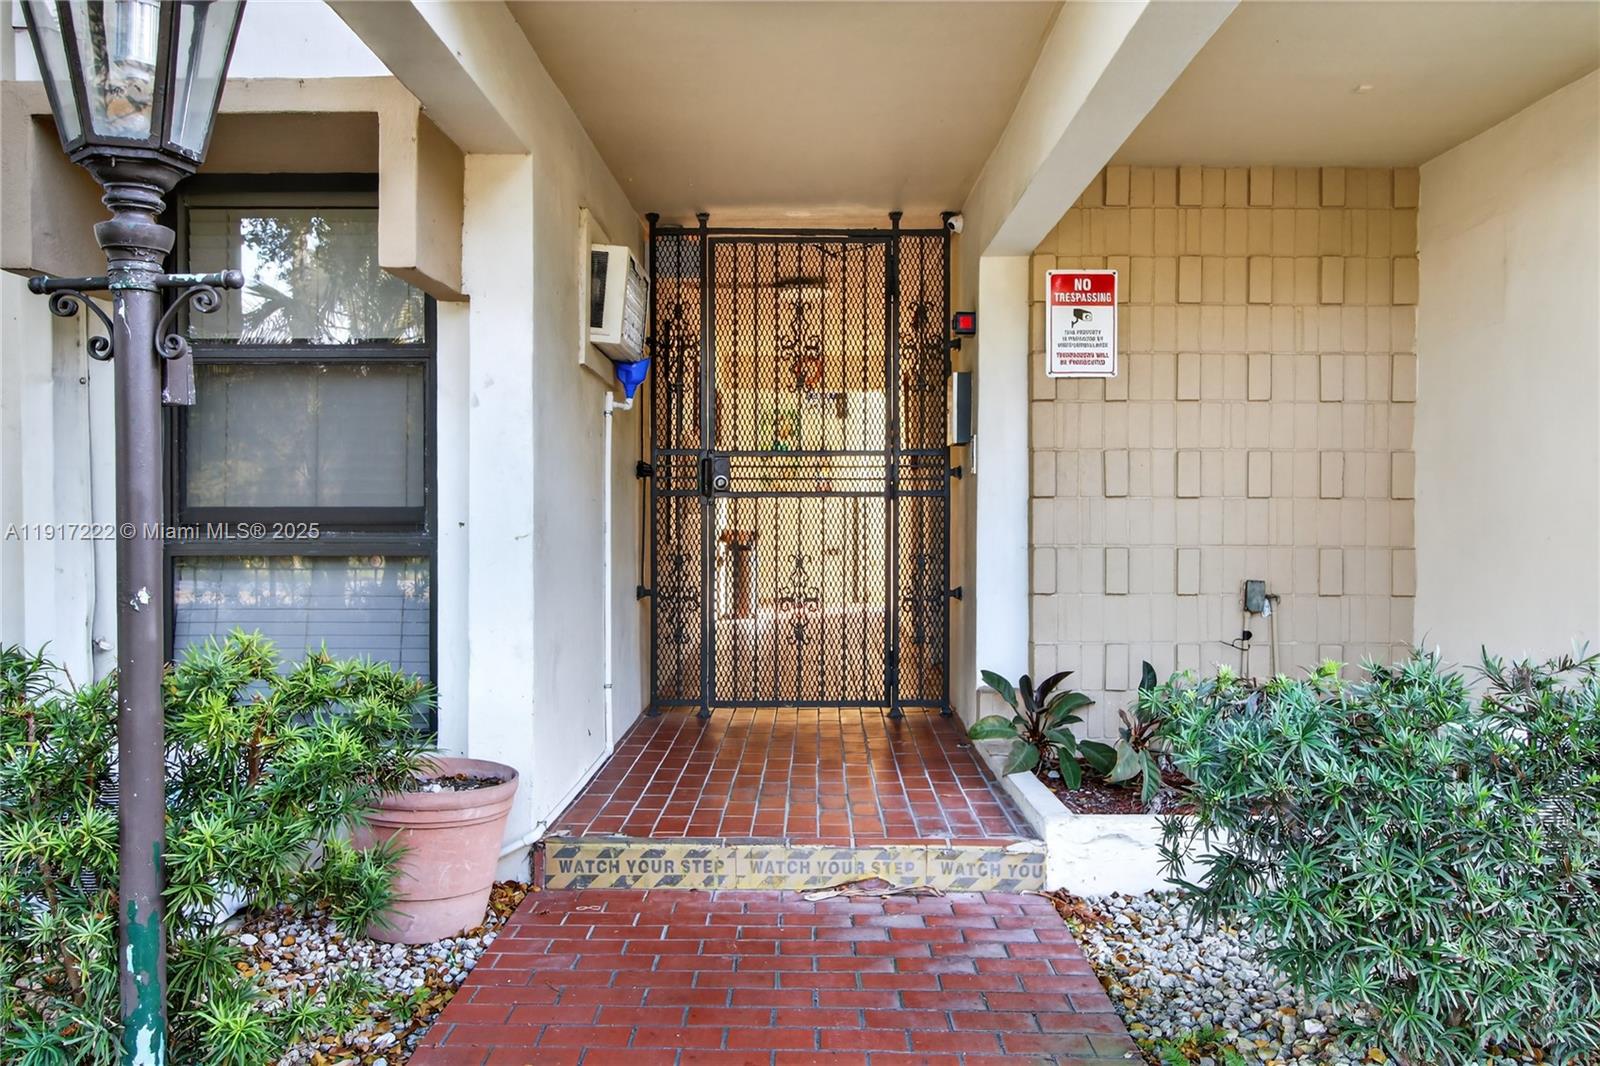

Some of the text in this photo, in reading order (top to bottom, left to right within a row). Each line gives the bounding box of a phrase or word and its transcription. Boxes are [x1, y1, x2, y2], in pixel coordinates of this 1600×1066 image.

[1074, 278, 1092, 291] NO
[1054, 292, 1112, 302] TRESPASSING
[559, 860, 724, 874] WATCH YOUR STEP
[750, 860, 915, 875] WATCH YOUR STEP
[941, 861, 1043, 878] WATCH YOU
